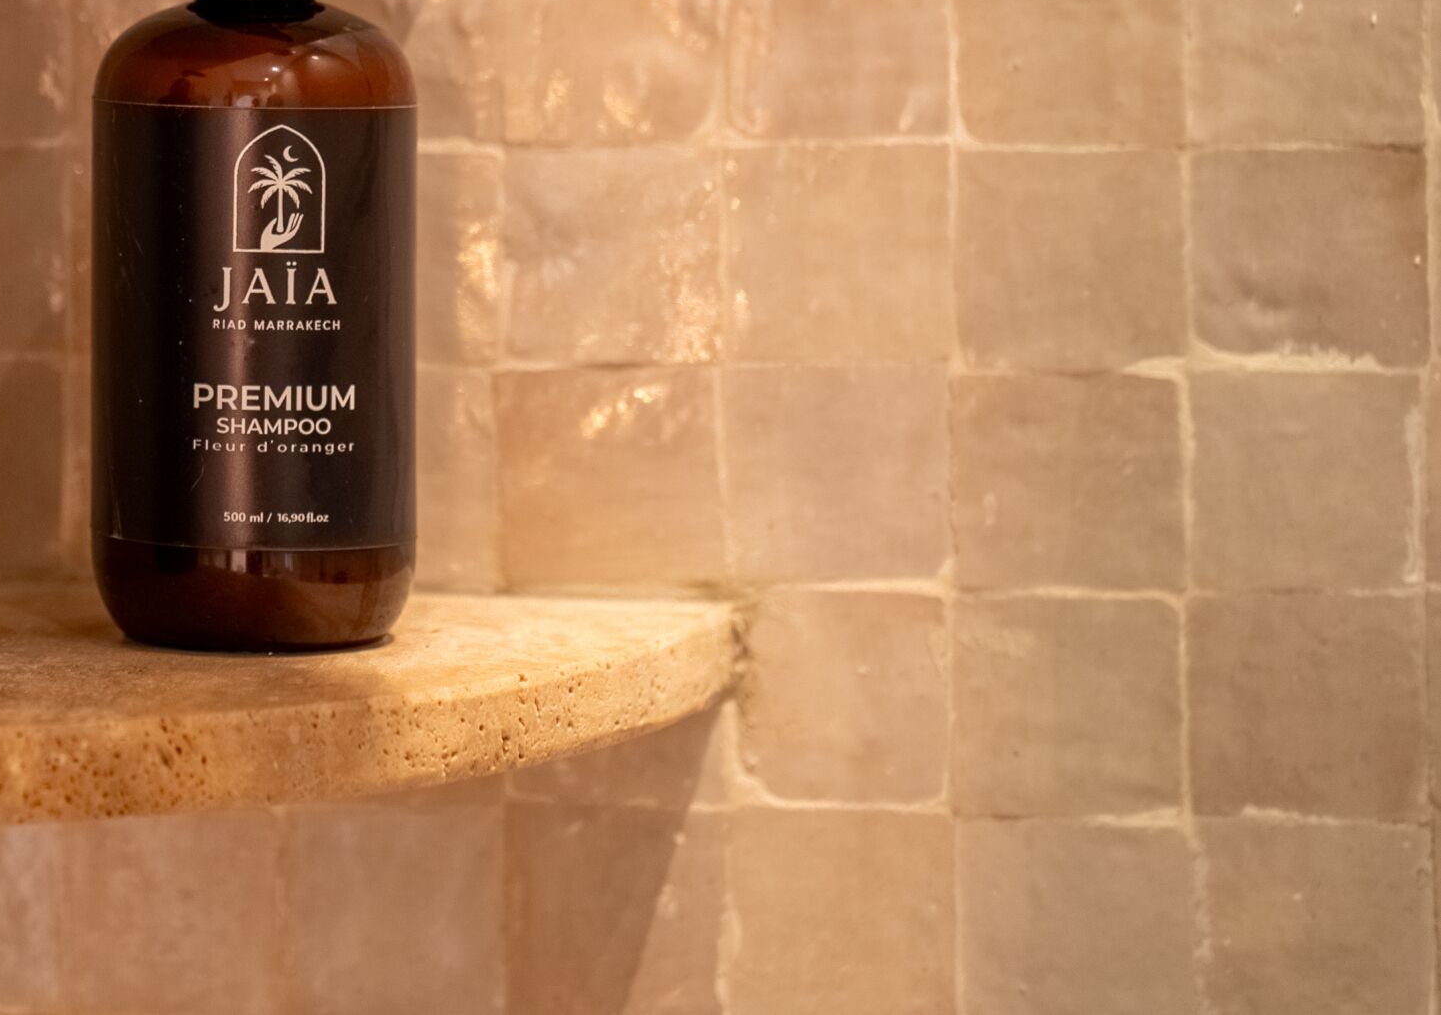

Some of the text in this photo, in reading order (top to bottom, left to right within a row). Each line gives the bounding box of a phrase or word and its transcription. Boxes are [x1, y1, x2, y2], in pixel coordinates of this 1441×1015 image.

[213, 261, 337, 312] JAÏA
[213, 319, 341, 331] RIAD MARRAKECH
[193, 384, 356, 411] PREMIUM
[216, 418, 332, 435] SHAMPOO
[192, 439, 356, 456] Fleur d'oranger
[223, 511, 247, 523] 500
[249, 512, 264, 523] ml
